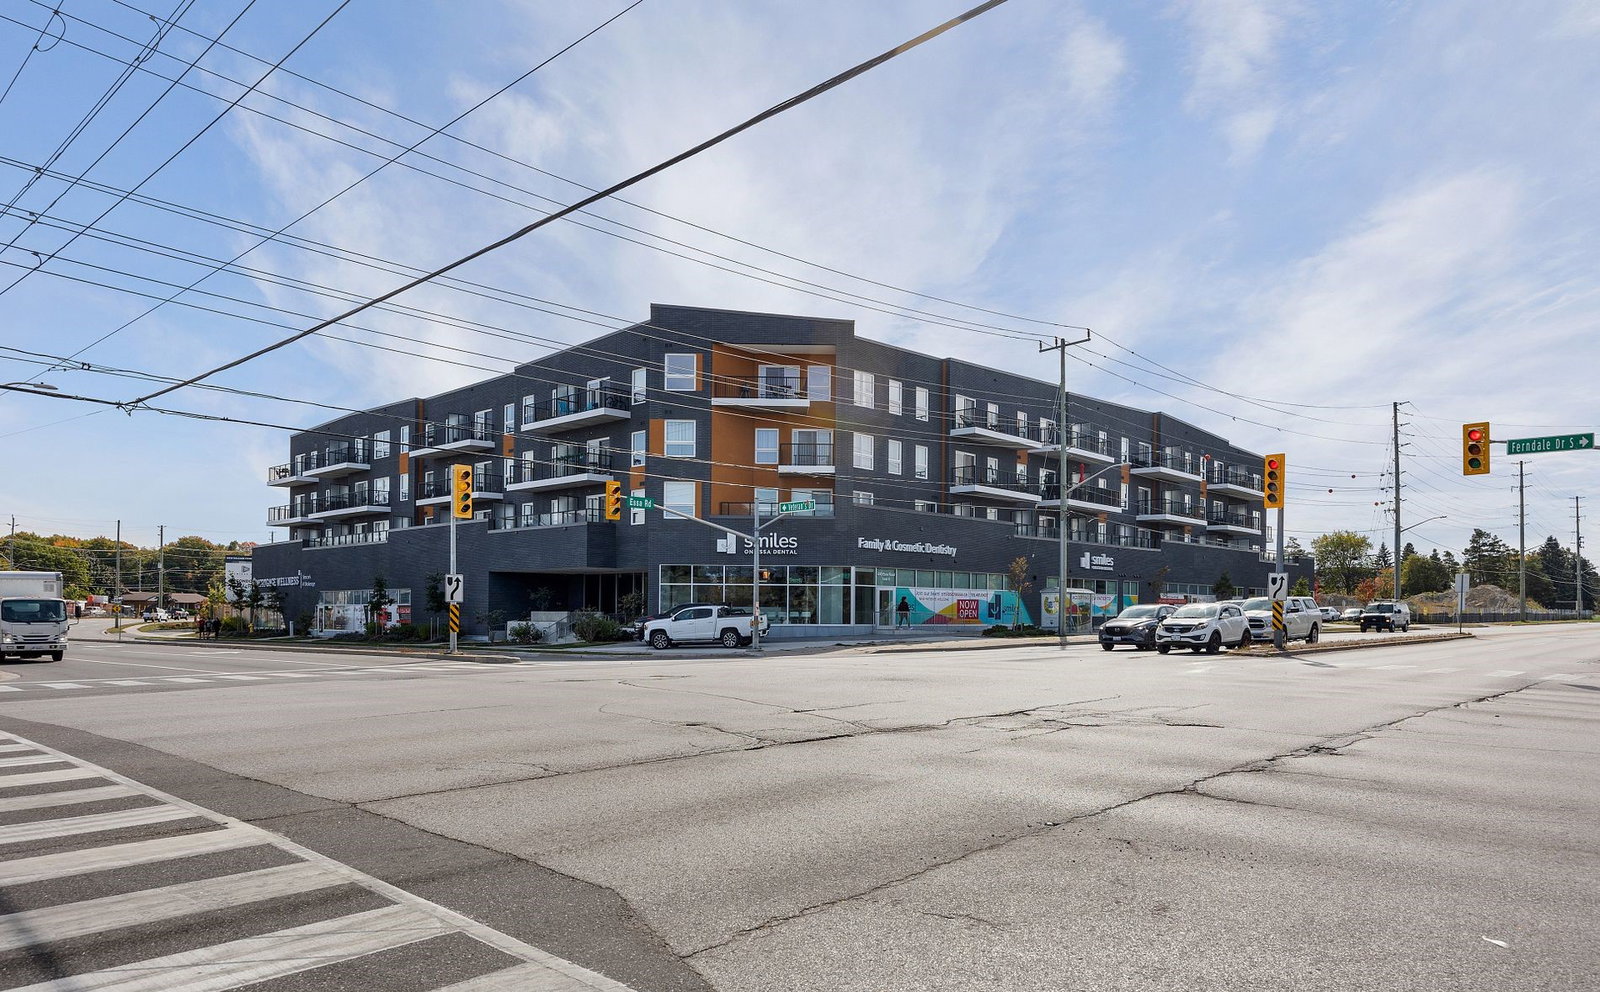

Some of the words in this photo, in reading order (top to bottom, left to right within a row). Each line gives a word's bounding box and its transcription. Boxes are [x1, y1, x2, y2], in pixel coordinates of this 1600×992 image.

[1511, 439, 1551, 453] Ferndale
[1555, 438, 1565, 450] Dr
[1569, 437, 1574, 449] S
[629, 498, 643, 507] Essa
[644, 499, 652, 508] Rd
[744, 532, 798, 548] smiles
[857, 537, 885, 552] Family
[884, 539, 892, 550] &
[892, 540, 925, 553] Cosmetic
[925, 543, 958, 557] Dentistry
[1091, 553, 1114, 566] smiles
[959, 600, 977, 609] NOW
[959, 610, 977, 619] OPEN
